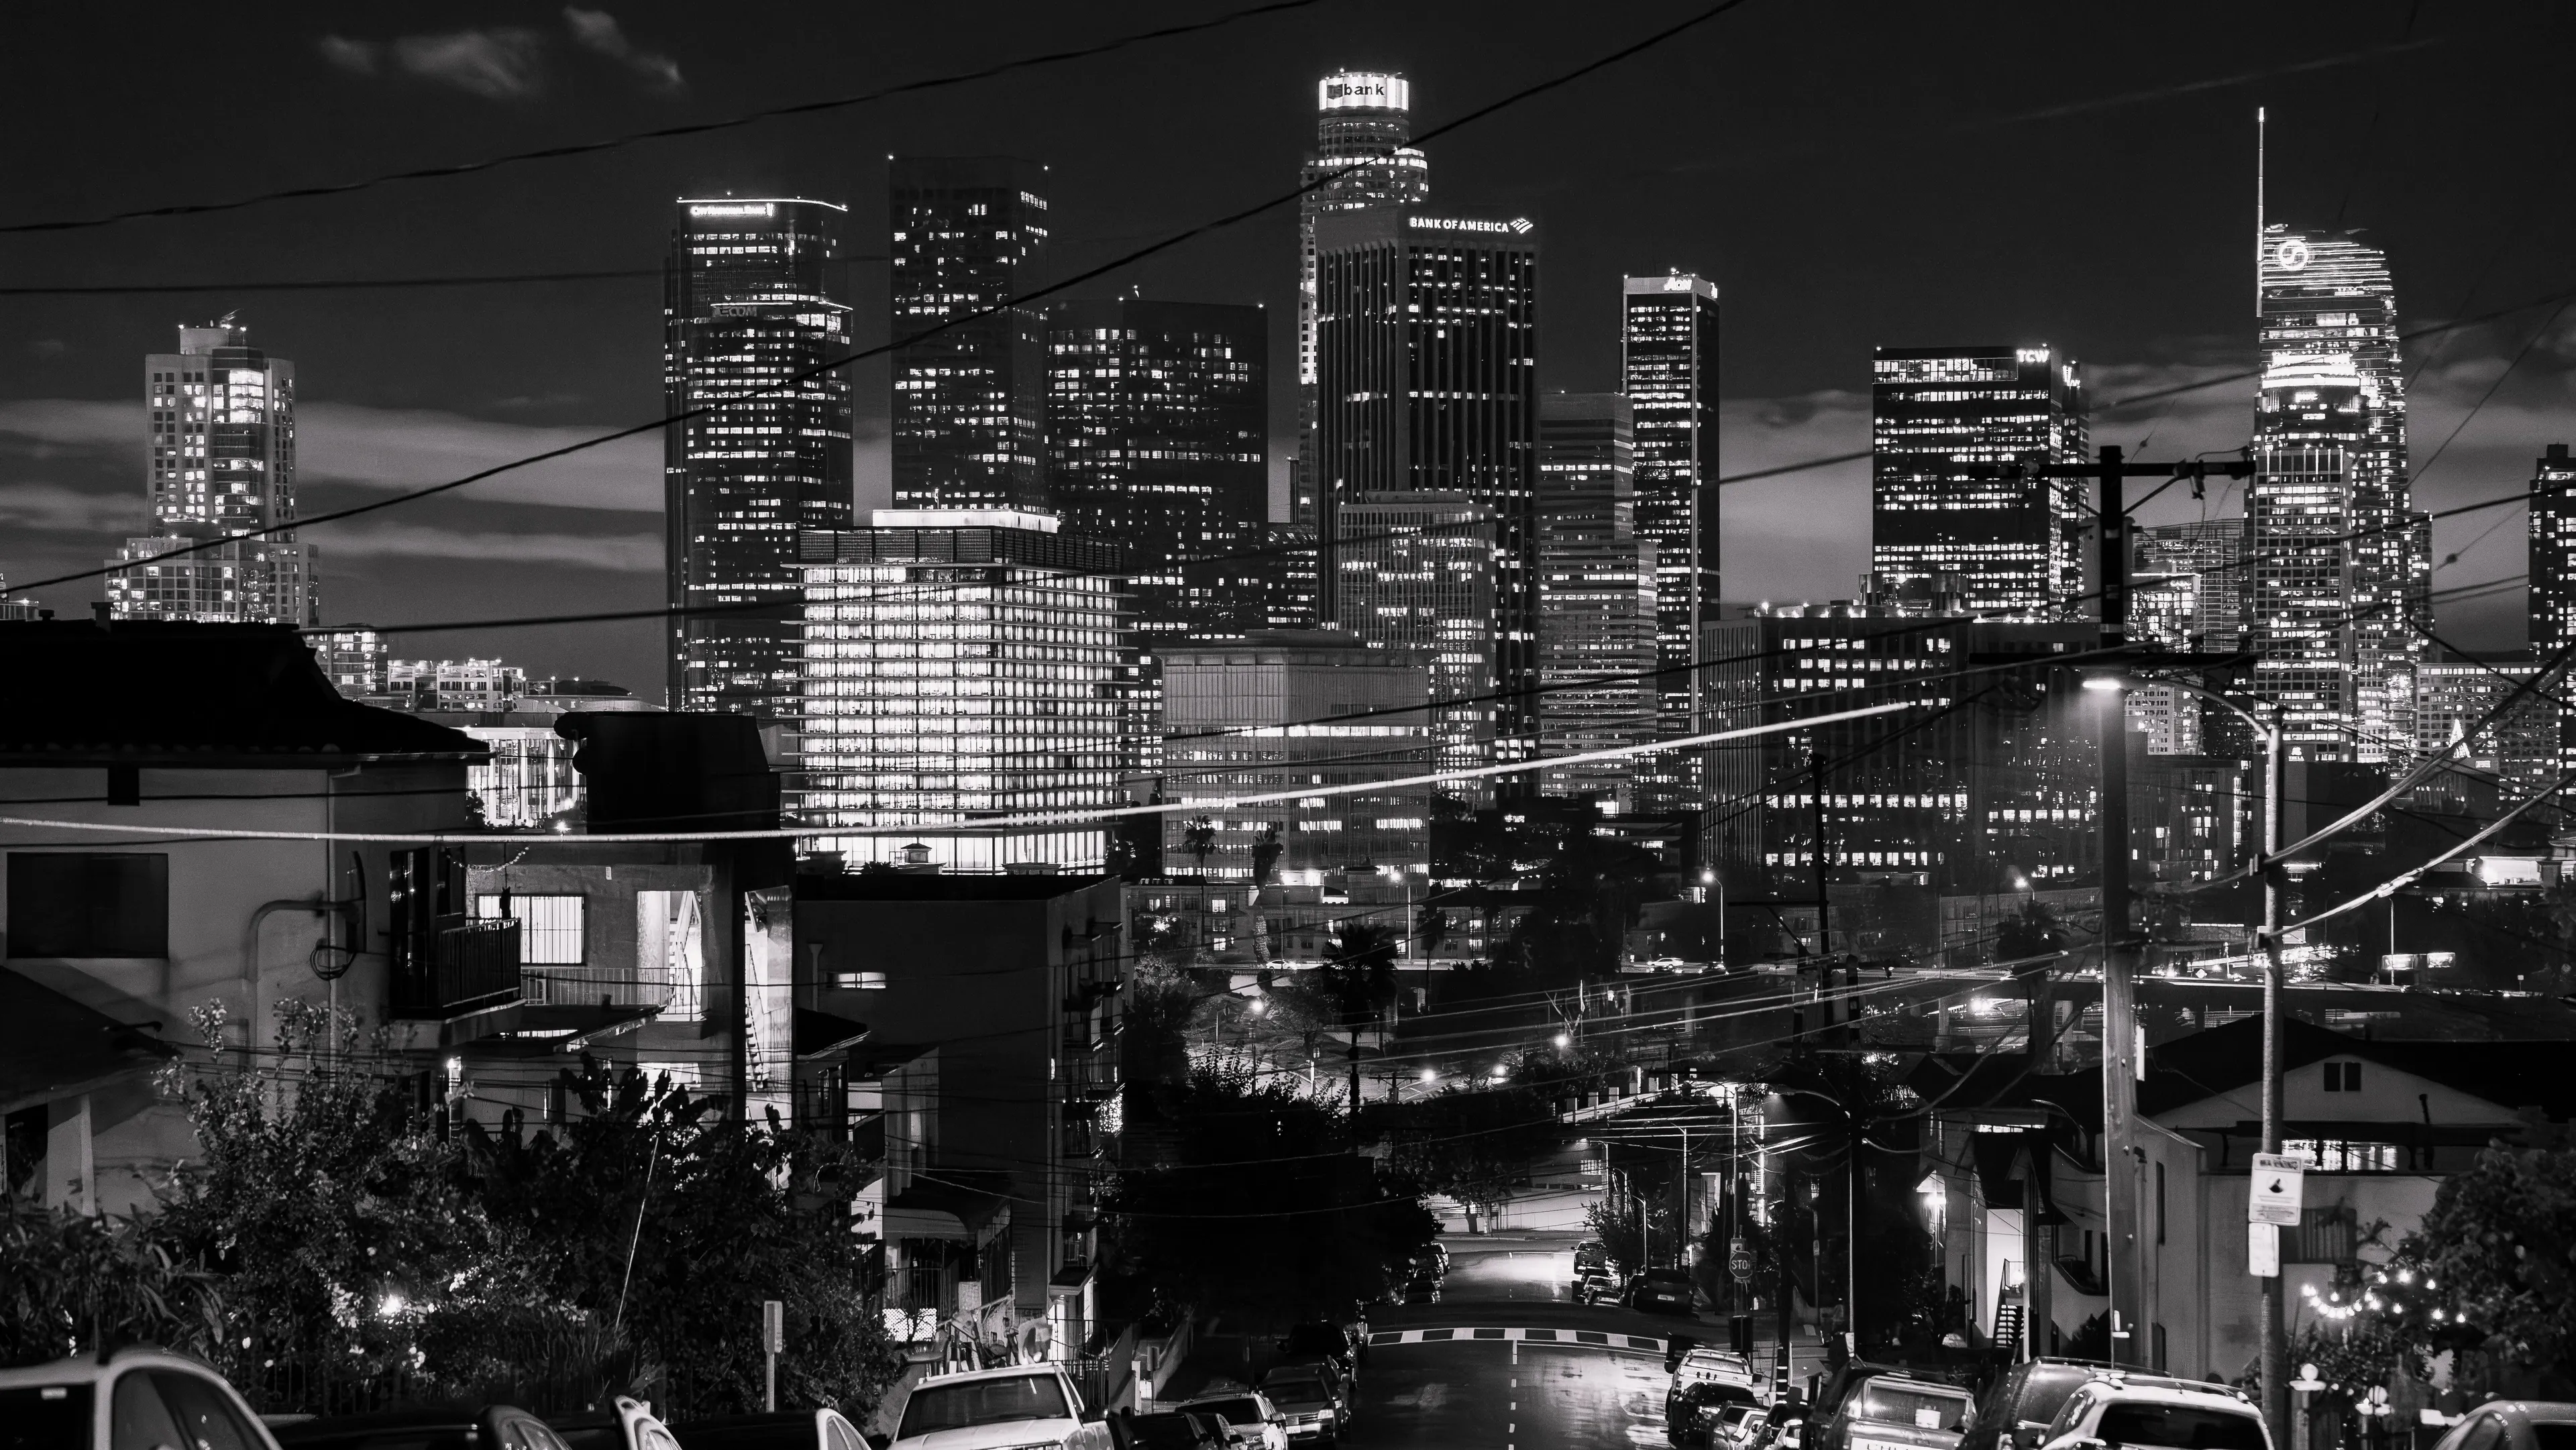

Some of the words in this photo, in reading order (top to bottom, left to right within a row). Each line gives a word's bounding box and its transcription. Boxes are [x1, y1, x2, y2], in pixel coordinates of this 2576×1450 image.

[1344, 83, 1385, 96] bank
[1409, 217, 1442, 229] BANK
[1442, 219, 1458, 229] OF
[1458, 219, 1509, 233] AMERICA
[2016, 349, 2050, 363] TCW
